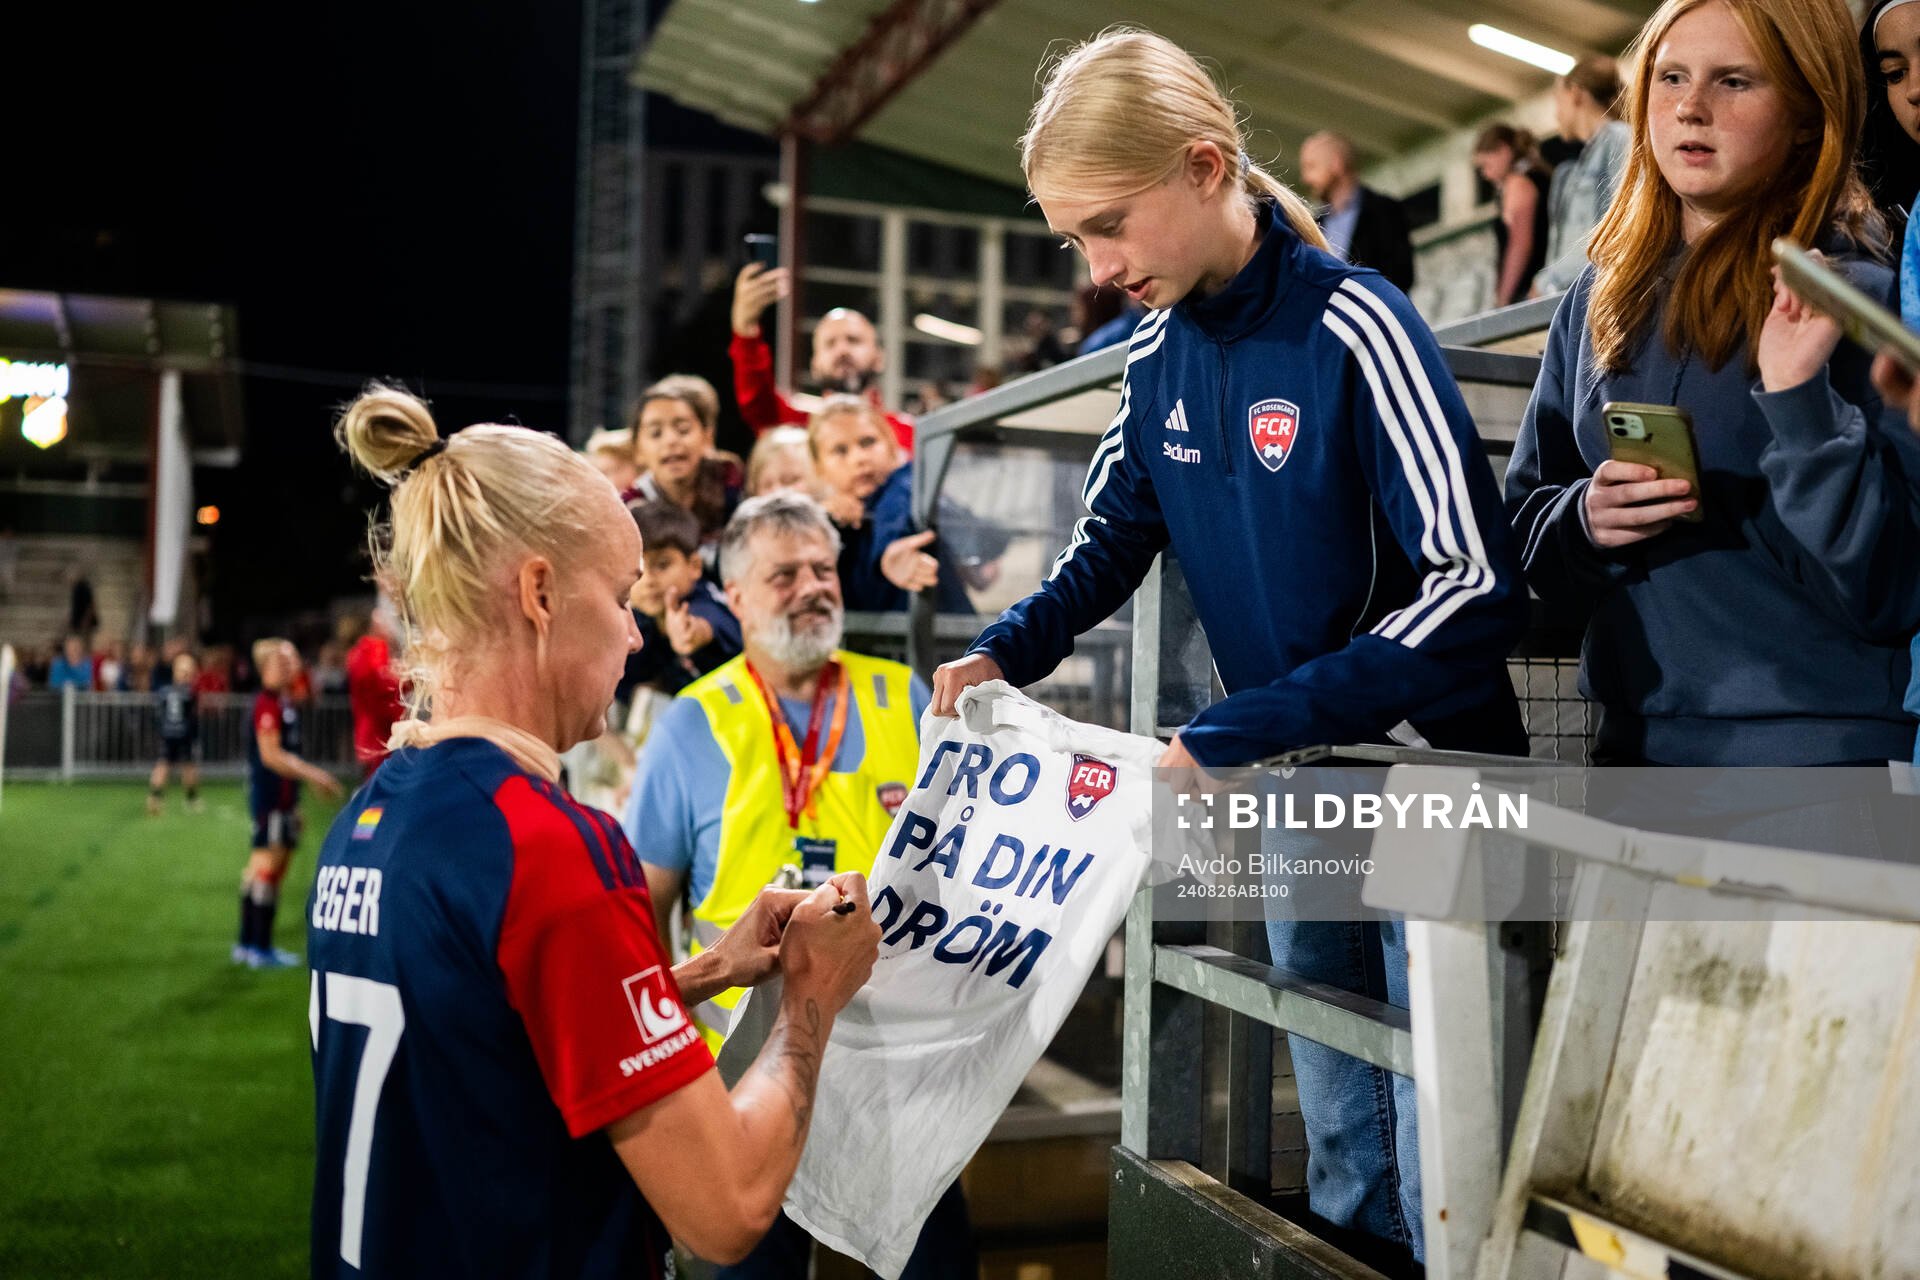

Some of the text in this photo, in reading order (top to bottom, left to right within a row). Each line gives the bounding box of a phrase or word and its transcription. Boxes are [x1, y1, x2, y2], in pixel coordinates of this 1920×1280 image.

[1255, 417, 1292, 436] FCR
[917, 740, 1041, 806] TRO
[1073, 766, 1111, 790] FCR
[888, 805, 1095, 906] PÅ DIN
[871, 885, 1053, 989] DRÖM
